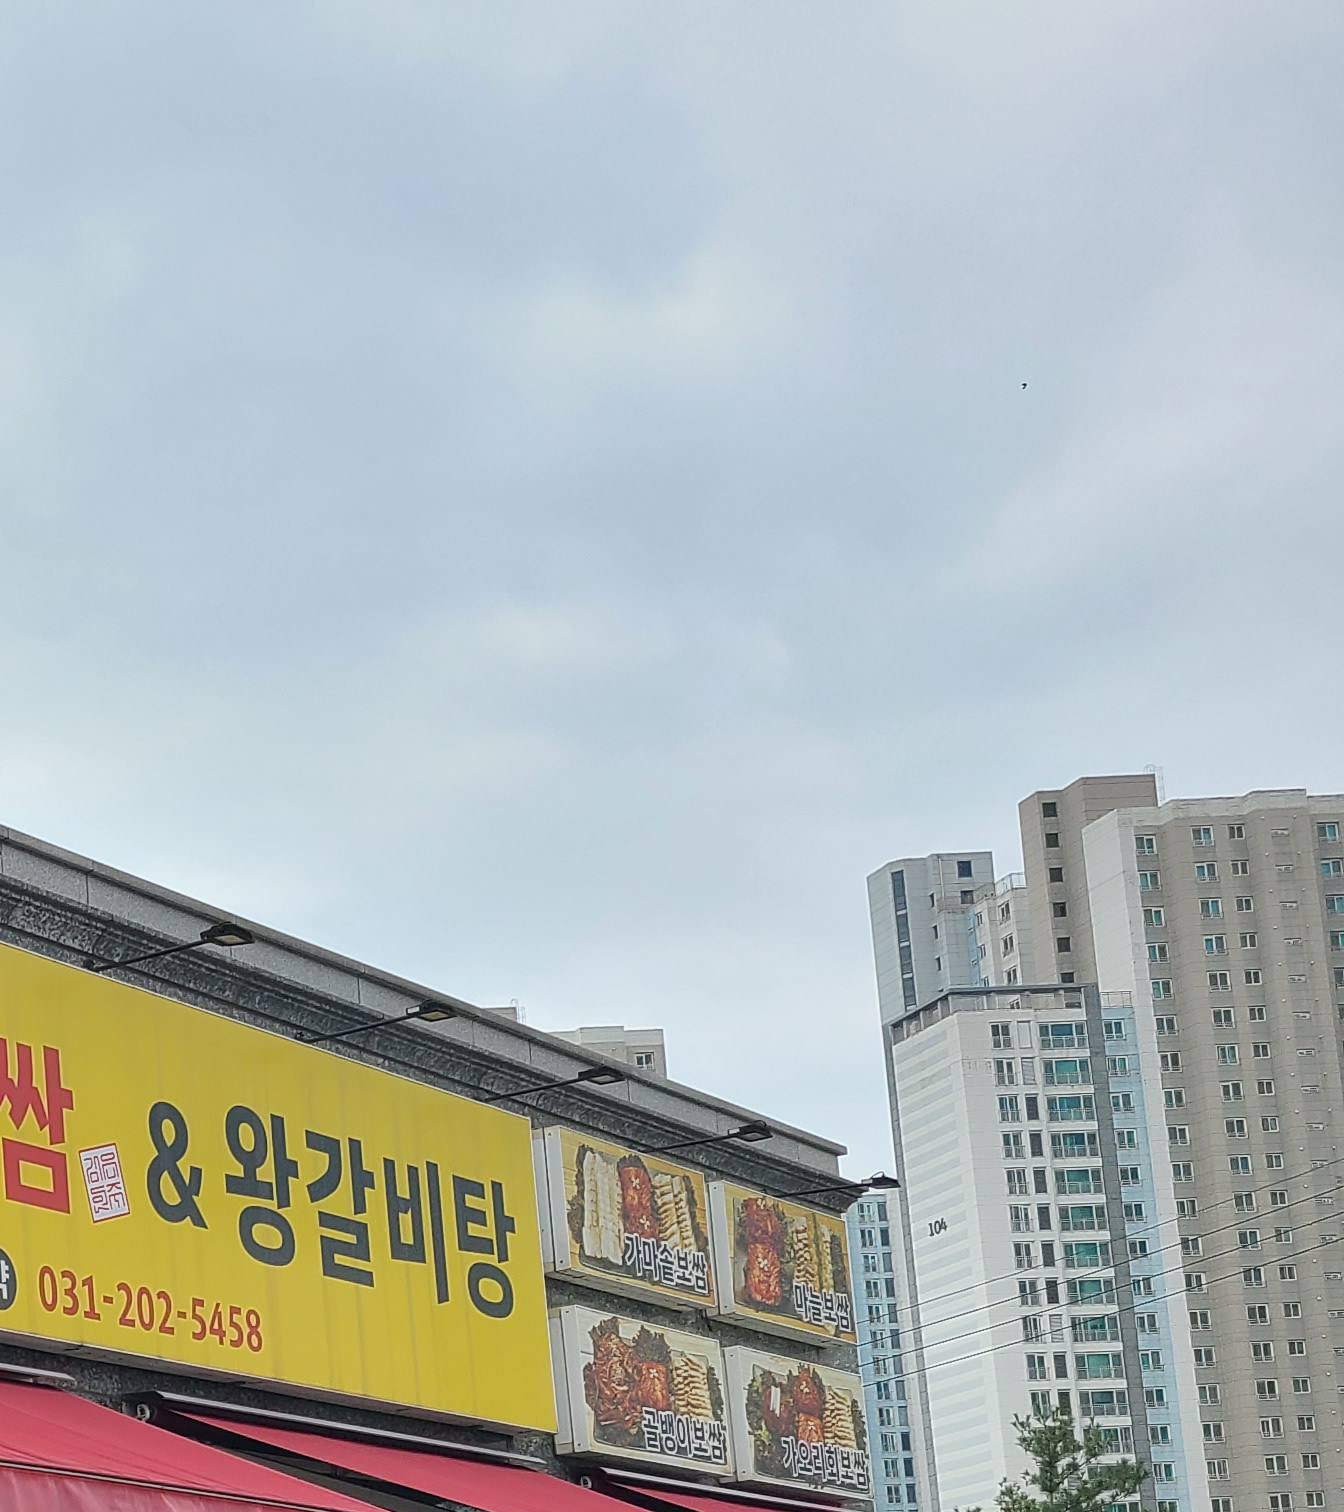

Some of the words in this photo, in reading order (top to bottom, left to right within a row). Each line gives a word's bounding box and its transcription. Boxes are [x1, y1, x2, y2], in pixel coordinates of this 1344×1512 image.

[146, 1101, 208, 1229] &
[223, 1103, 516, 1319] 왕갈비탕
[928, 1217, 948, 1237] 104
[623, 1232, 709, 1295] 가마솥보쌈
[38, 1264, 264, 1354] 031-202-5458
[793, 1281, 850, 1331] 마늘보쌈
[641, 1405, 727, 1465] 골뱅이보쌈
[780, 1435, 870, 1487] 가오리회보쌈
